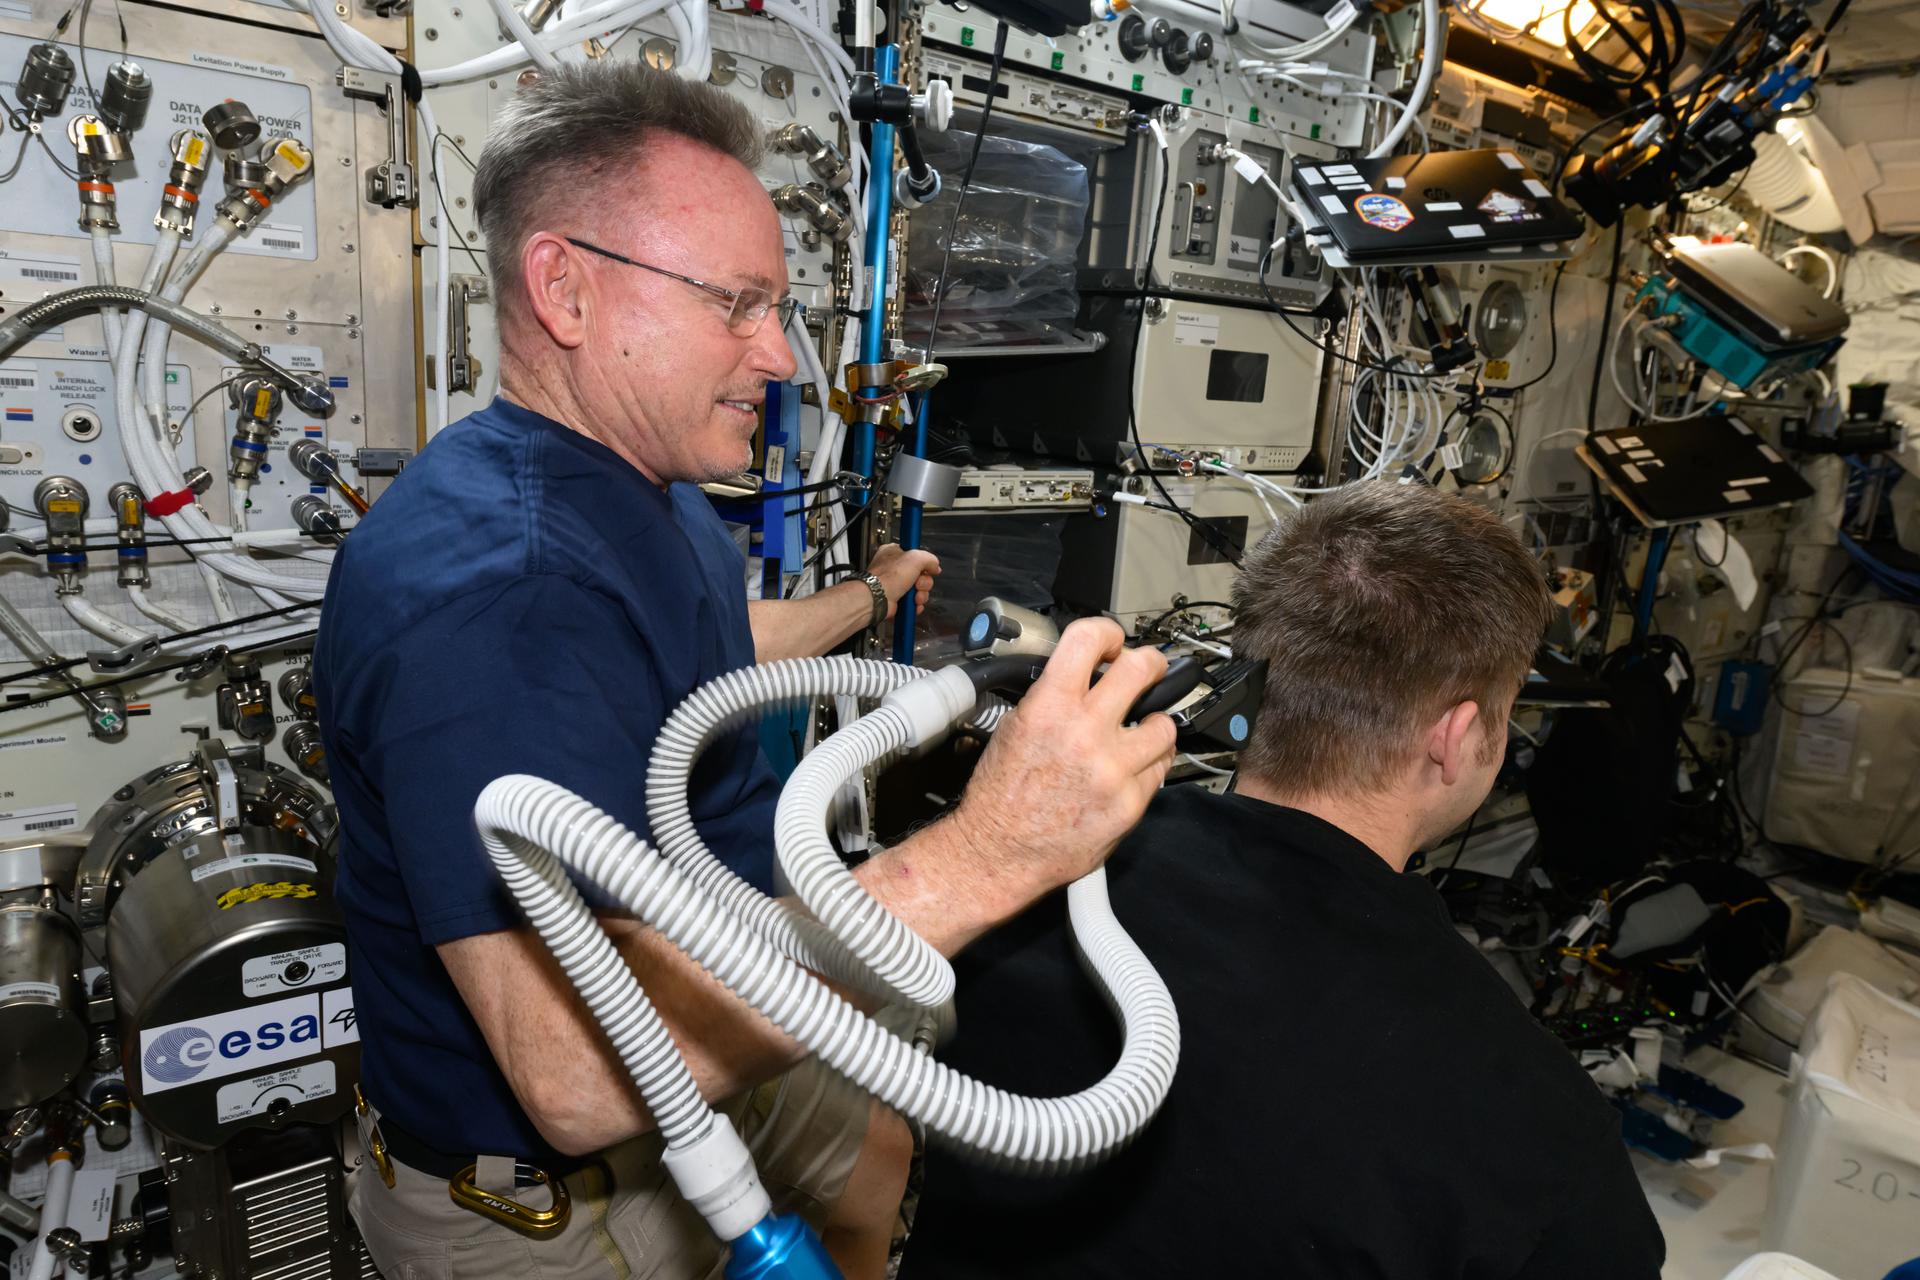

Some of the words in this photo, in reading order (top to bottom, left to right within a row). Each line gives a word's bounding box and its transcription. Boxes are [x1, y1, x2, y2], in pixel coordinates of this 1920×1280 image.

[193, 54, 232, 68] Levitation
[234, 62, 258, 72] Power
[260, 66, 286, 78] Supply
[68, 84, 102, 99] DATA
[169, 101, 202, 115] DATA
[172, 114, 200, 126] J211
[257, 115, 302, 130] POWER
[57, 377, 98, 385] INTERNAL
[84, 385, 106, 393] LOCK
[36, 736, 66, 744] Module
[317, 960, 344, 969] FORWARD
[218, 1014, 319, 1059] esa
[482, 1198, 517, 1214] CAMP
